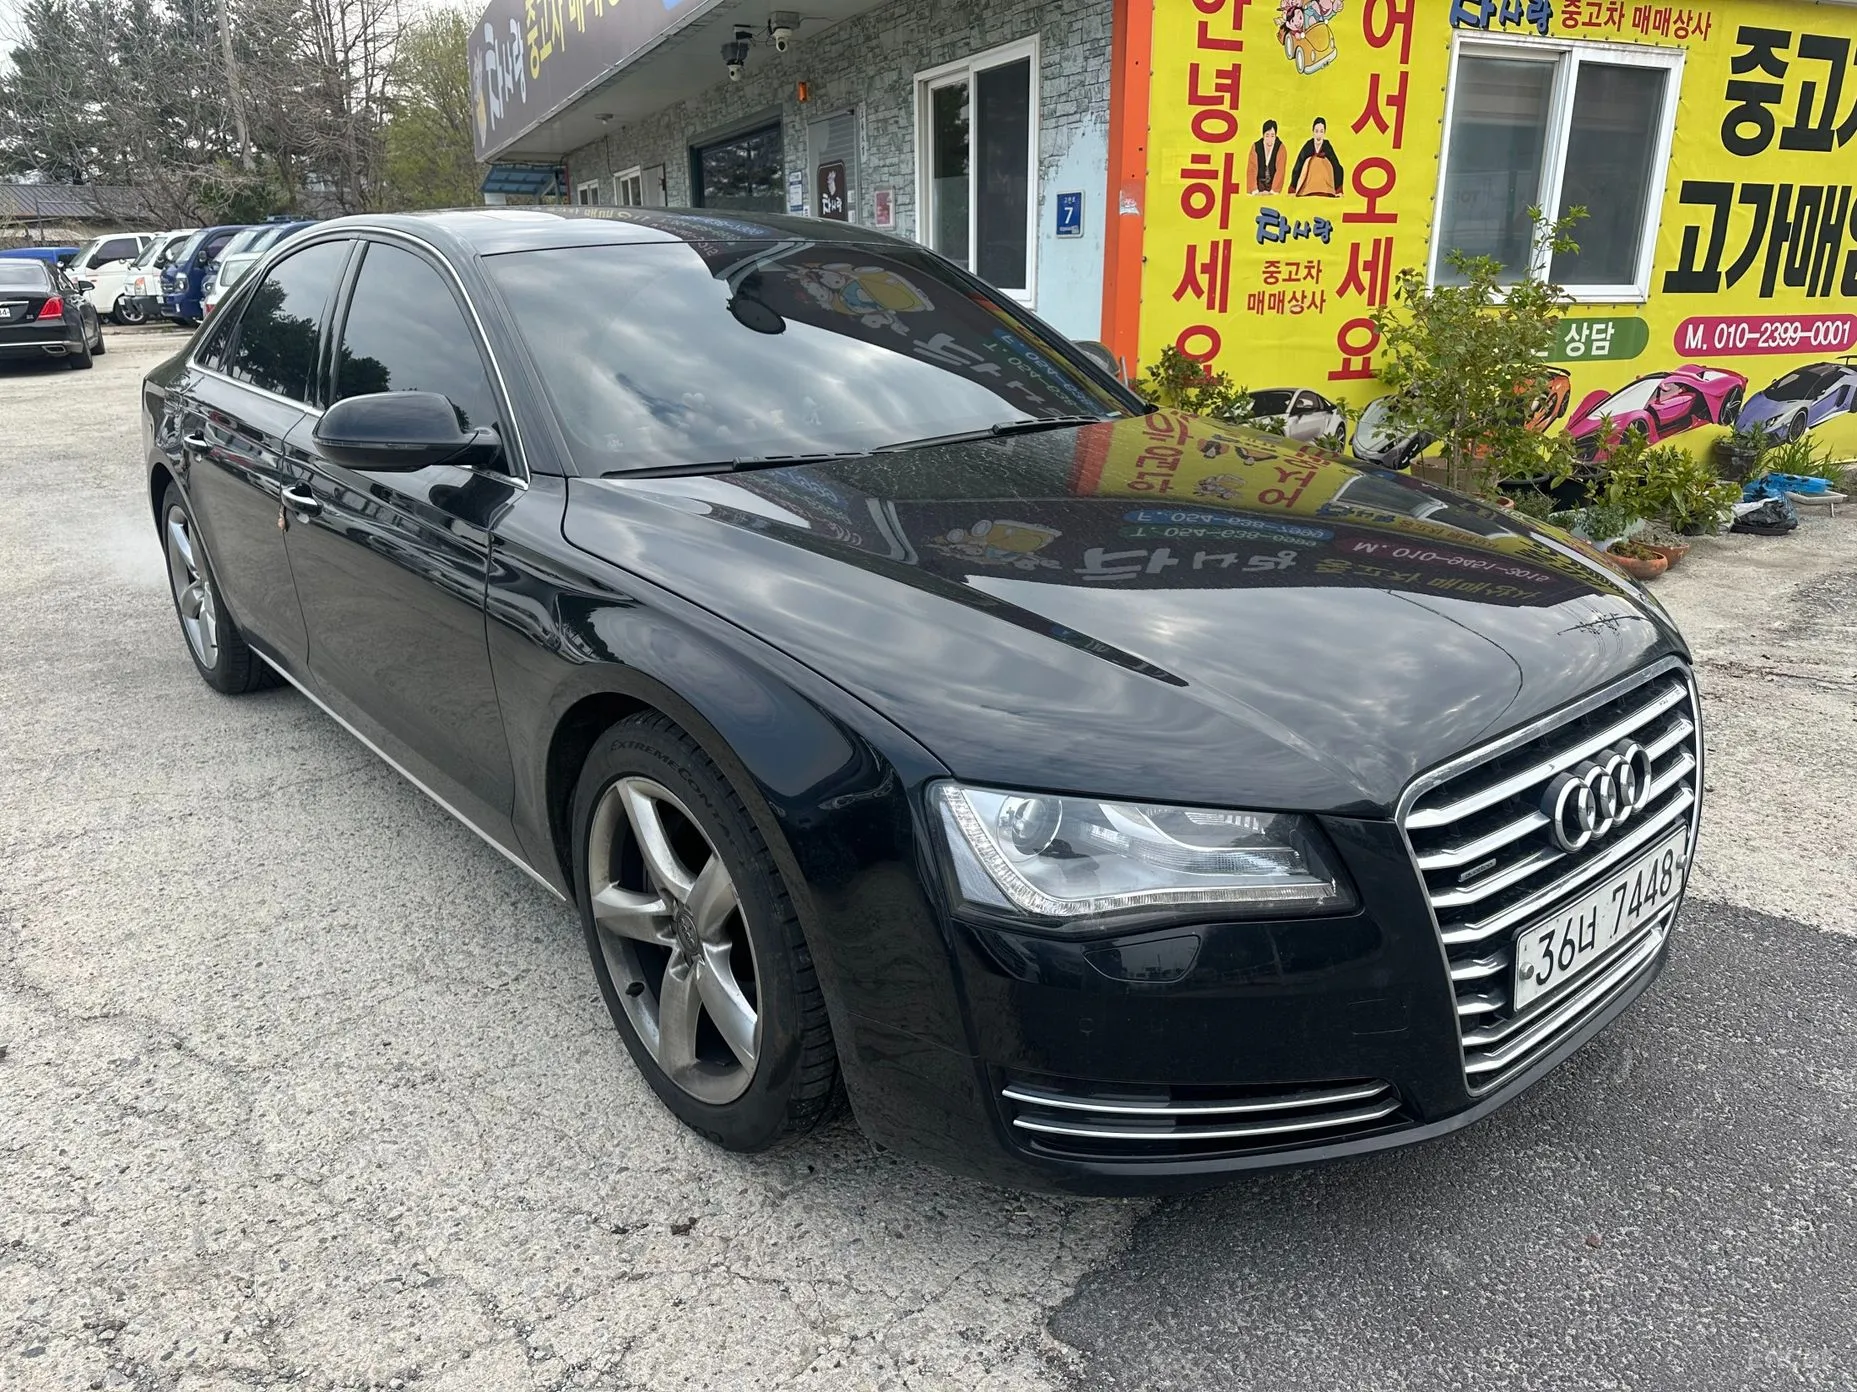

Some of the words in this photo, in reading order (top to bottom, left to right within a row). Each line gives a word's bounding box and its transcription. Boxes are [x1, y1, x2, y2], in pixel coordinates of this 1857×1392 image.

[1560, 0, 1625, 32] 중고차
[1632, 5, 1712, 41] 매매상사
[484, 18, 526, 131] 차사랑
[1721, 25, 1857, 157] 중고
[1327, 0, 1415, 381] 어서오세요
[1064, 206, 1074, 224] 7
[1256, 207, 1333, 244] 차사랑
[1662, 180, 1857, 299] 고가매
[1262, 260, 1322, 286] 중고차
[1247, 290, 1326, 315] 매매상사
[1564, 321, 1615, 355] 상담
[1685, 324, 1707, 350] M.
[1714, 320, 1850, 347] 010-2399-0001
[1611, 848, 1674, 936] 7448
